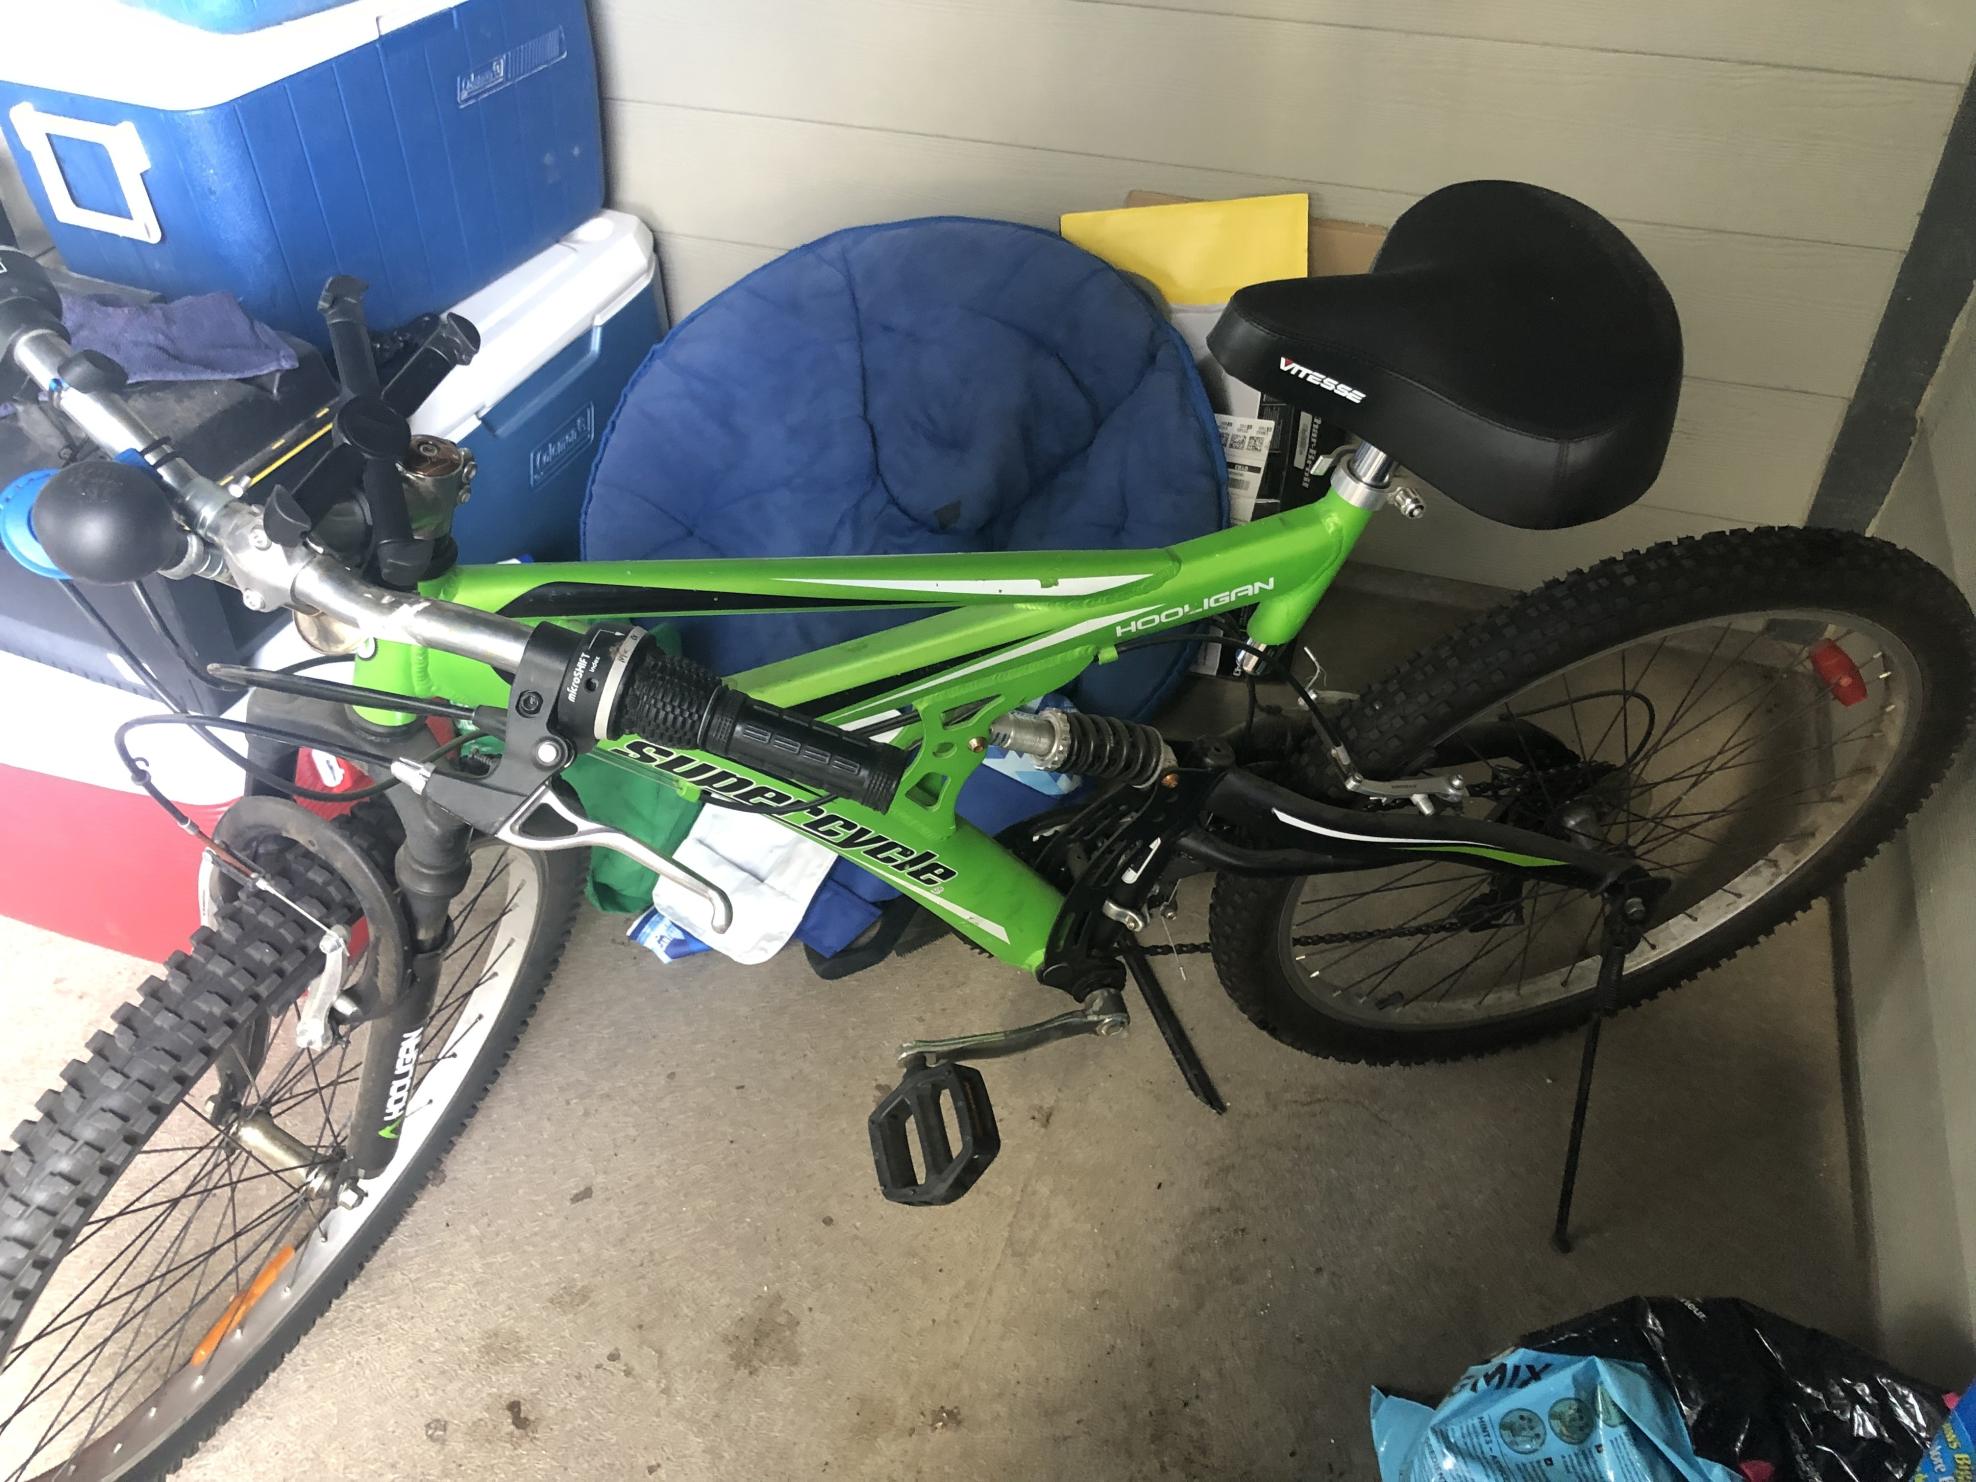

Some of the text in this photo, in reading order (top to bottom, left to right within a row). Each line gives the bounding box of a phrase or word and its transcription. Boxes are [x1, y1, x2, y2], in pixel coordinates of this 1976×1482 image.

[1280, 357, 1366, 404] VITESSE
[1116, 577, 1275, 637] HOOLIGAN
[567, 652, 590, 703] microSHIFT
[384, 1027, 423, 1120] HOOLIGAN
